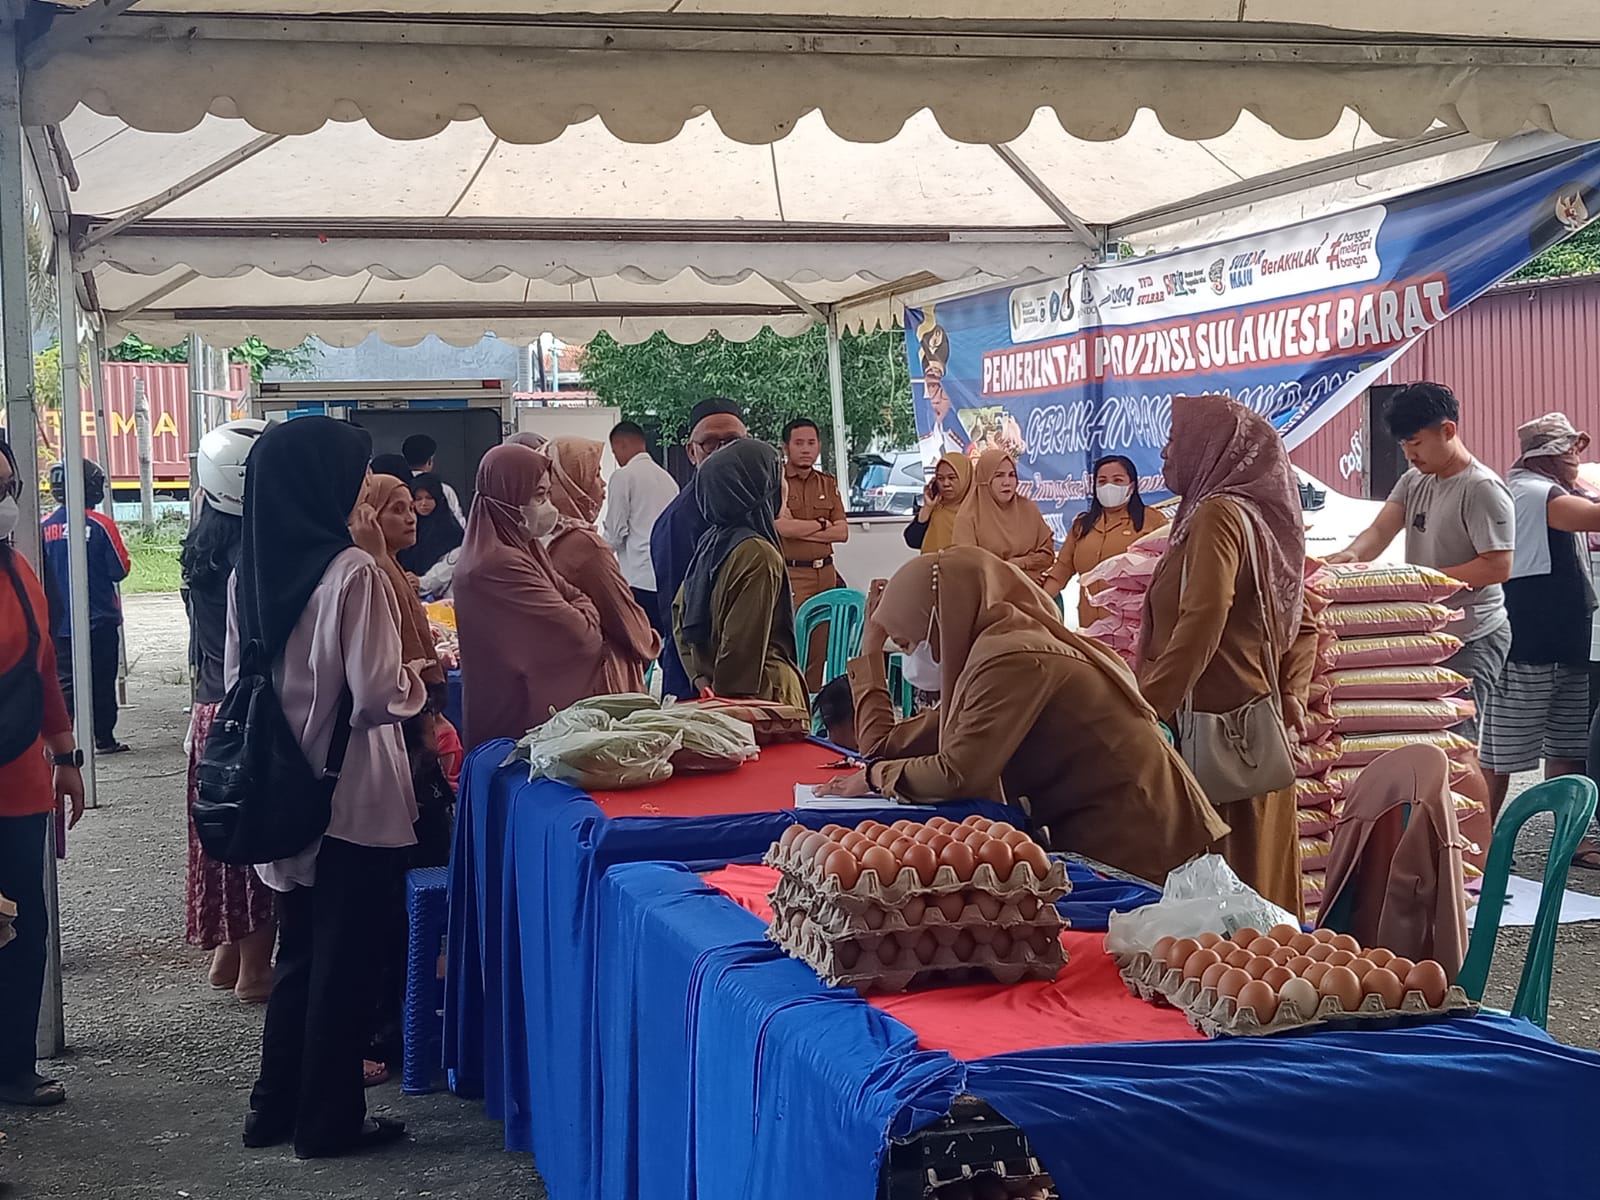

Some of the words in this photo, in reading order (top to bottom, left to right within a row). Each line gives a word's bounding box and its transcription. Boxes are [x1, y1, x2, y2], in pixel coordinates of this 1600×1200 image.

[1229, 268, 1254, 289] MAJU
[1261, 246, 1320, 276] BerAKHLAK
[983, 338, 1087, 394] PEMERINTAH
[1195, 301, 1332, 369] SULAWESI
[1336, 281, 1446, 350] BARAT
[1025, 396, 1134, 465] GERAKAN
